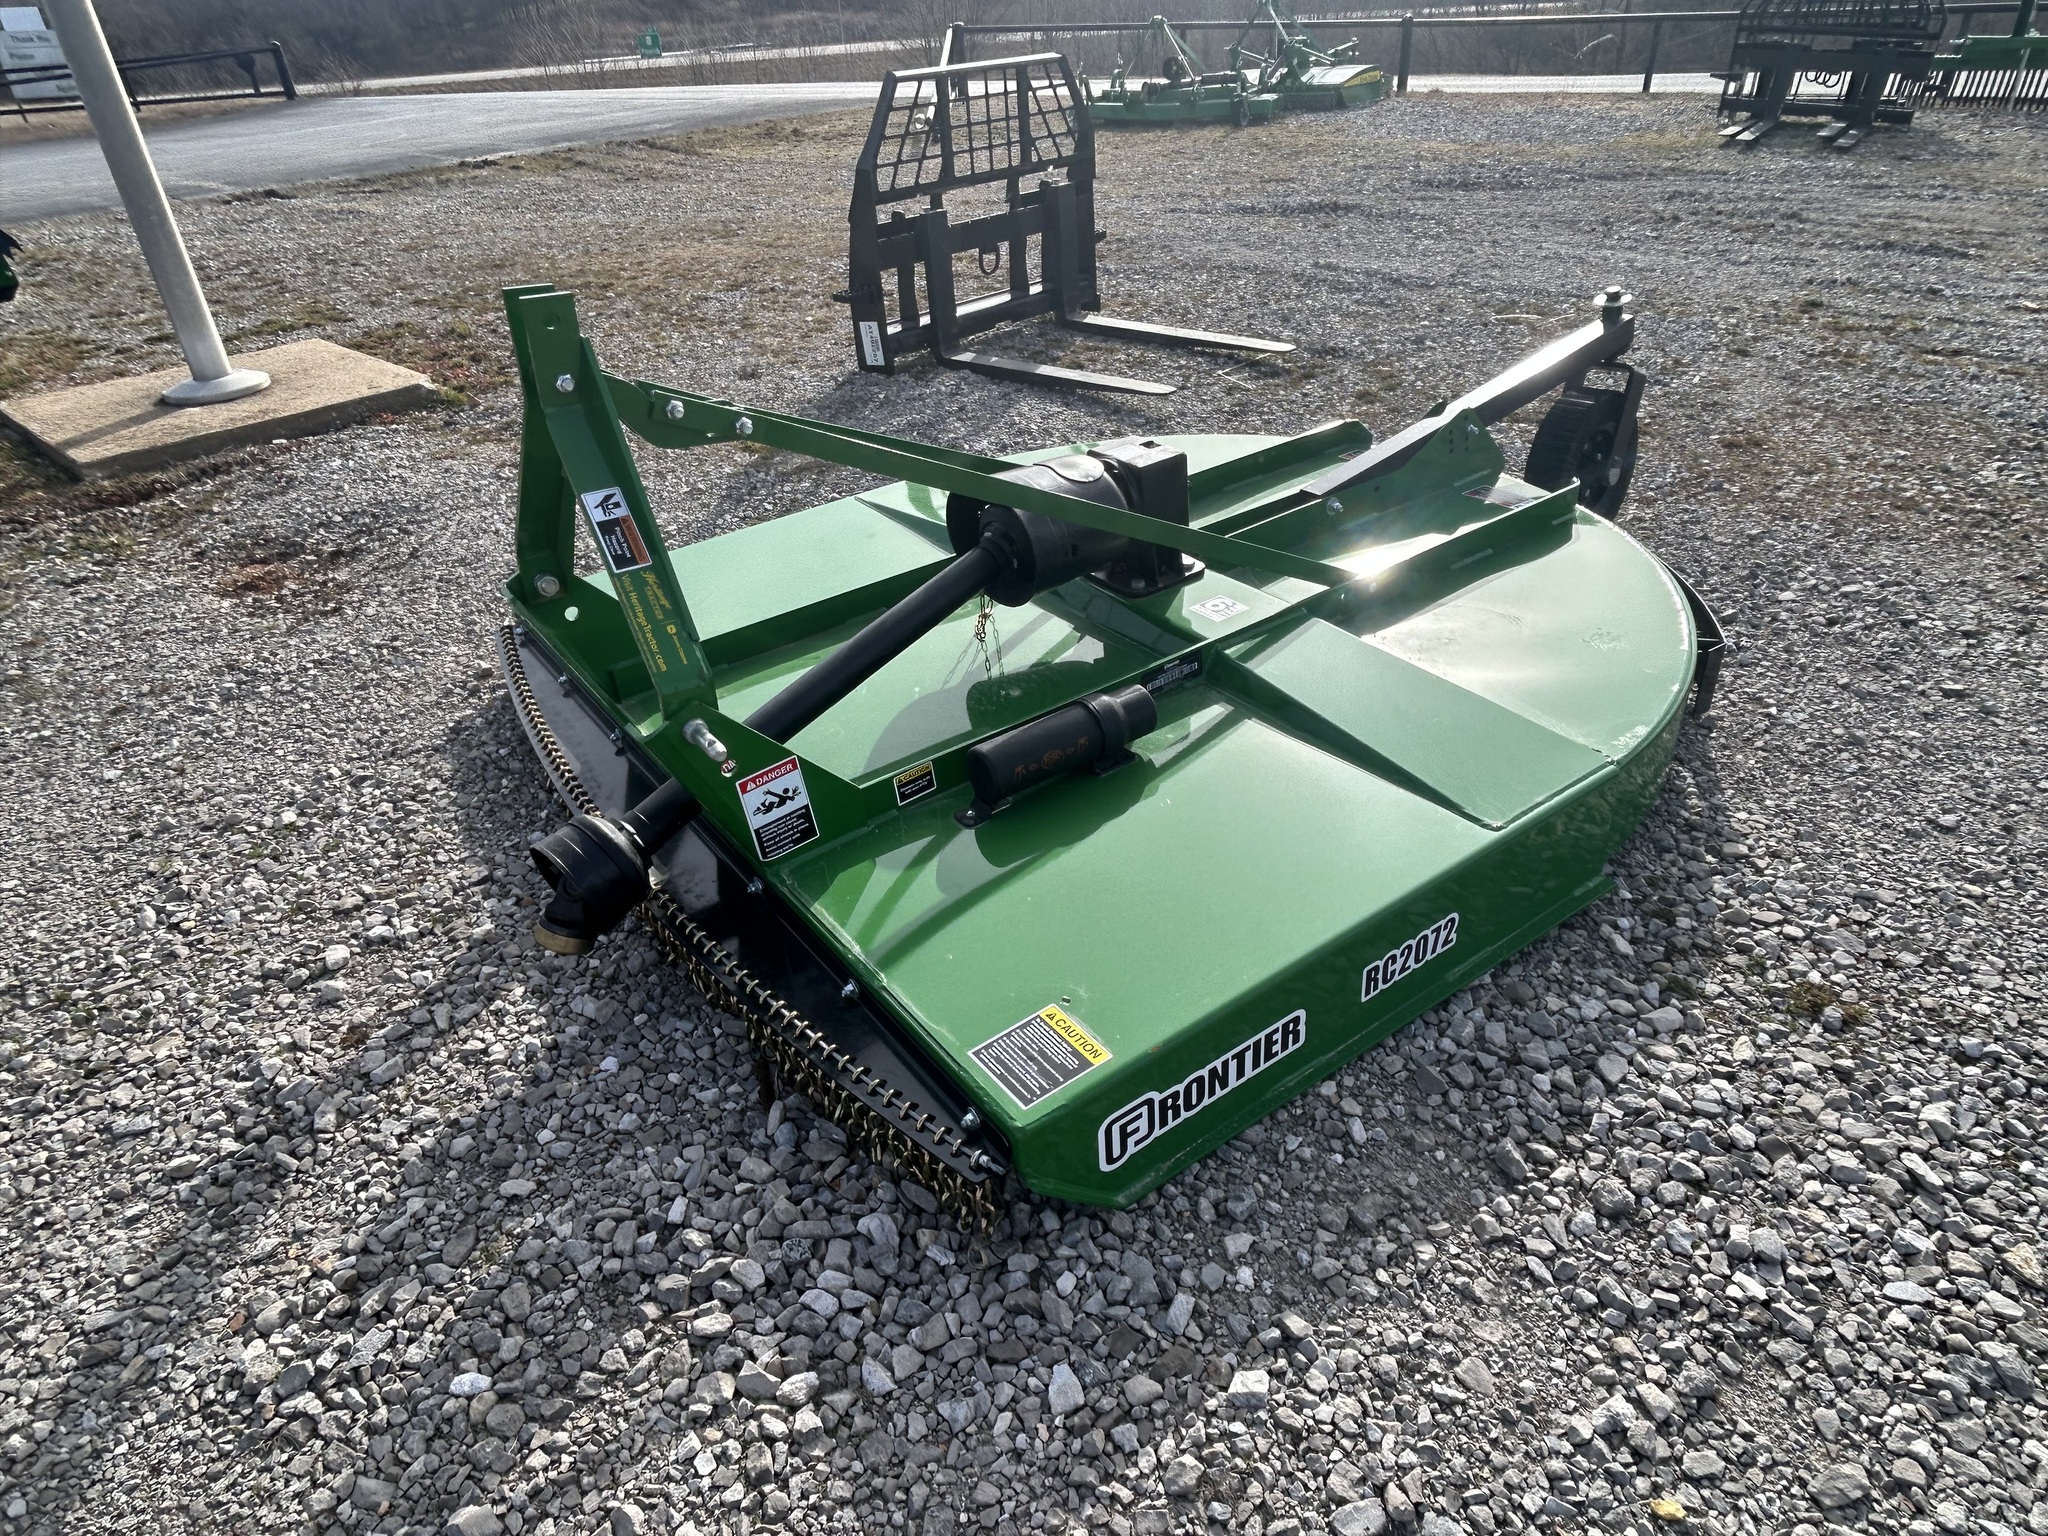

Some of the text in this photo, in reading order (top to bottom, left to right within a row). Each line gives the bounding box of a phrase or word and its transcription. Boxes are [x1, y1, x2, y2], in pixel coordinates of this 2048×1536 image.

[629, 592, 667, 672] HeritageTractor.com
[755, 762, 794, 786] DANGER
[1363, 915, 1458, 999] RC2072
[1054, 1018, 1103, 1060] CAUTION
[1103, 1014, 1302, 1167] FRONTIER
